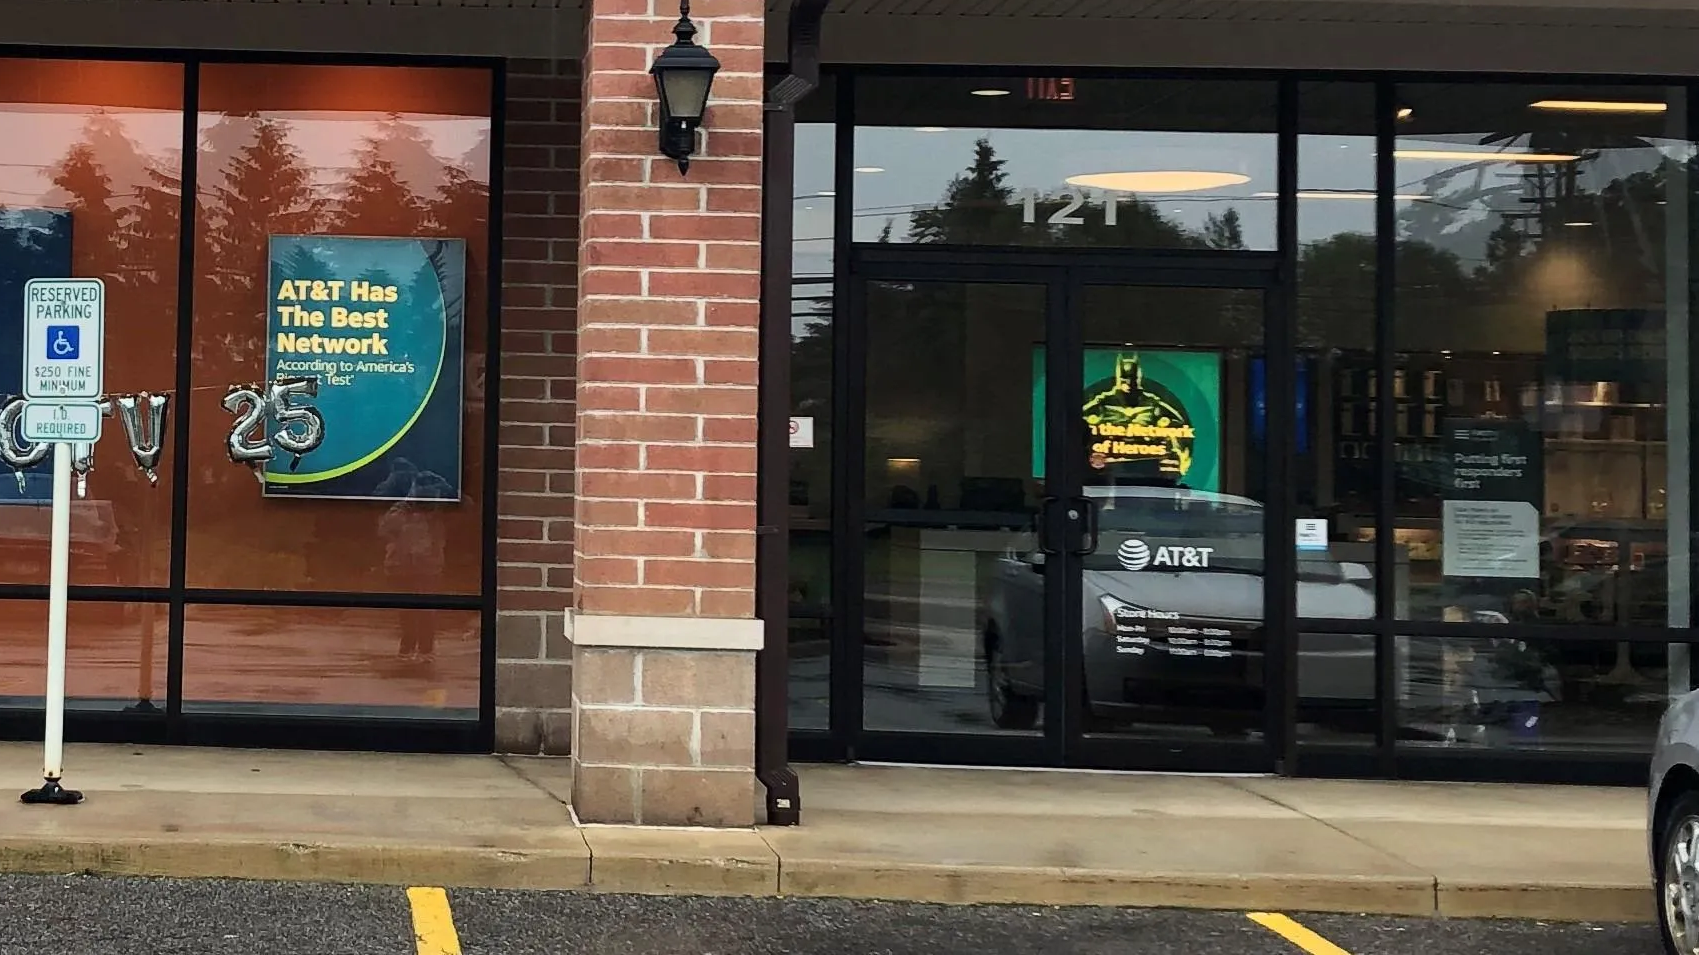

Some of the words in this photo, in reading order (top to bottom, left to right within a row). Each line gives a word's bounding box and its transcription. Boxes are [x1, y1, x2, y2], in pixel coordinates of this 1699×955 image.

[1021, 188, 1117, 226] 121
[31, 287, 98, 302] RESERVED
[276, 279, 345, 301] AT&T
[350, 280, 398, 302] Has
[36, 304, 92, 319] PARKING
[276, 305, 325, 327] The
[331, 306, 389, 329] Best
[276, 332, 389, 355] Network
[35, 366, 61, 378] $250
[67, 366, 92, 378] FINE
[276, 359, 337, 374] According
[339, 361, 353, 372] to
[356, 360, 415, 373] America's
[220, 377, 327, 460] 25
[36, 422, 87, 435] REQUIRED
[1091, 440, 1112, 453] of
[1152, 546, 1215, 568] AT&T
